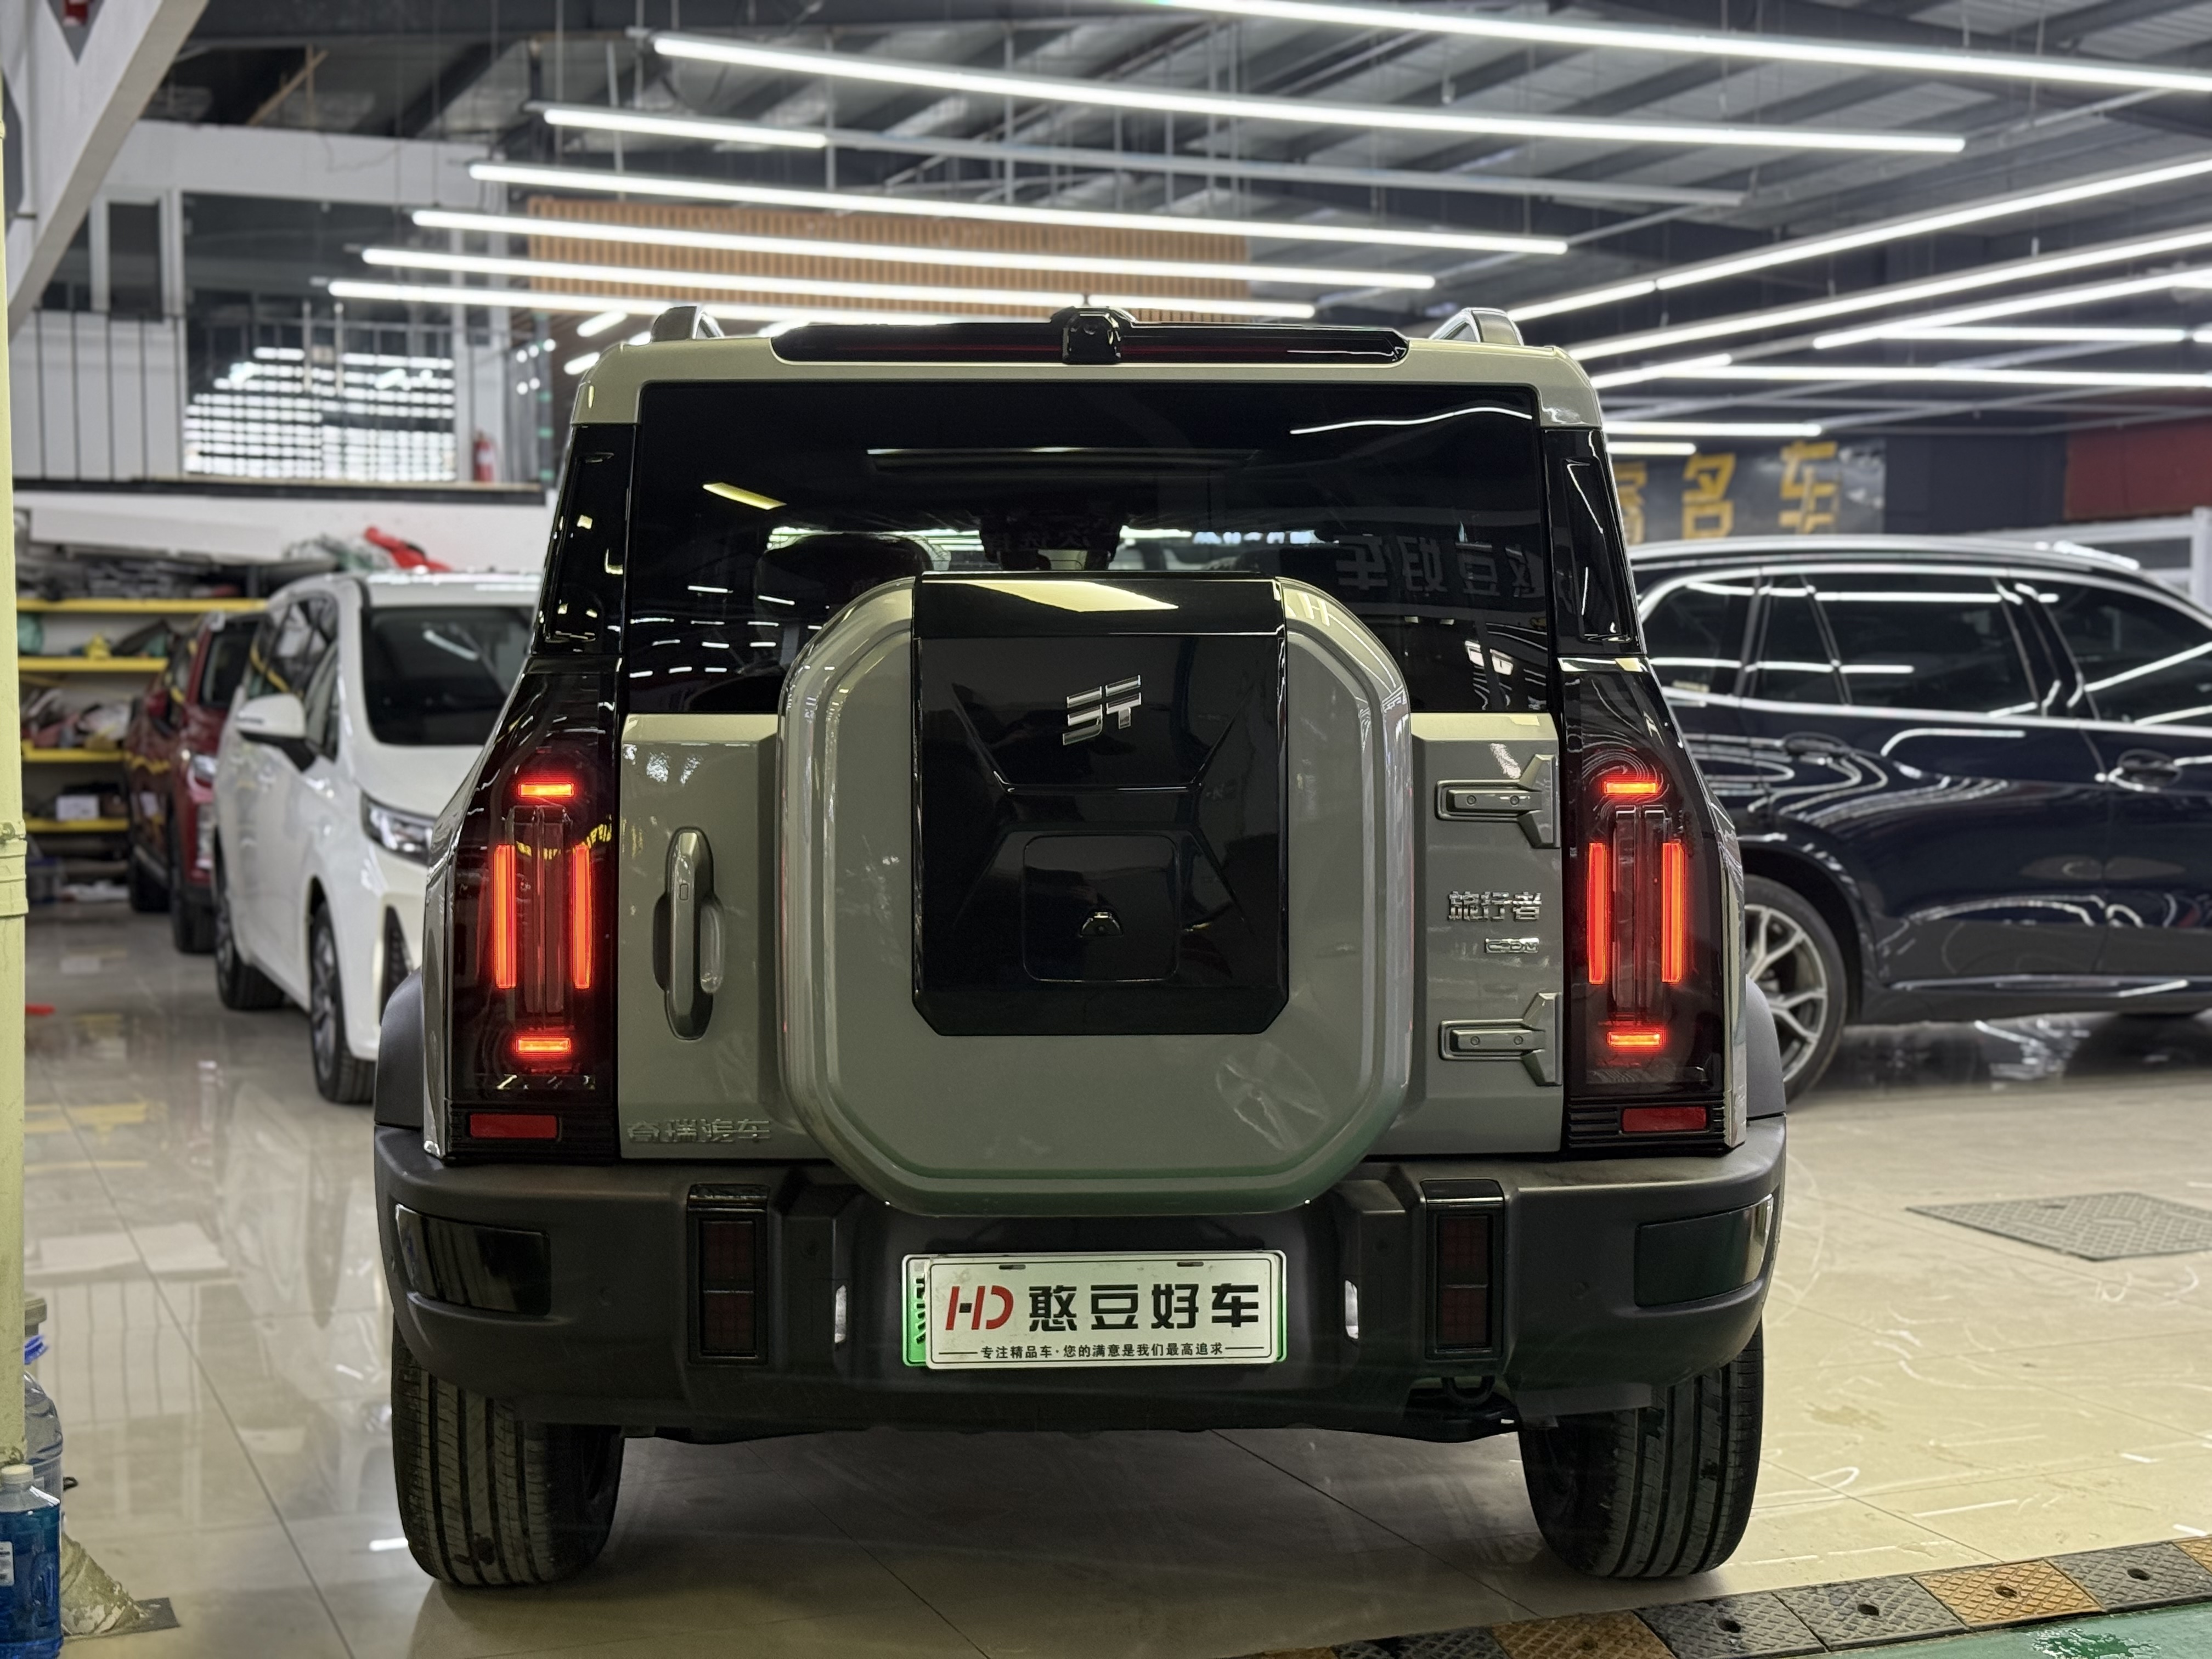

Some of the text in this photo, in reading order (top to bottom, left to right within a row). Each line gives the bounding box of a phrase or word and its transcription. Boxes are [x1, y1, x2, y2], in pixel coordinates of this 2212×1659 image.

[1448, 890, 1542, 922] 旅行者
[627, 1118, 770, 1143] 奇瑞汽车
[1029, 1283, 1260, 1332] 憨豆好车
[980, 1342, 1223, 1359] 专注精品车·您的满意是我们最高追求
